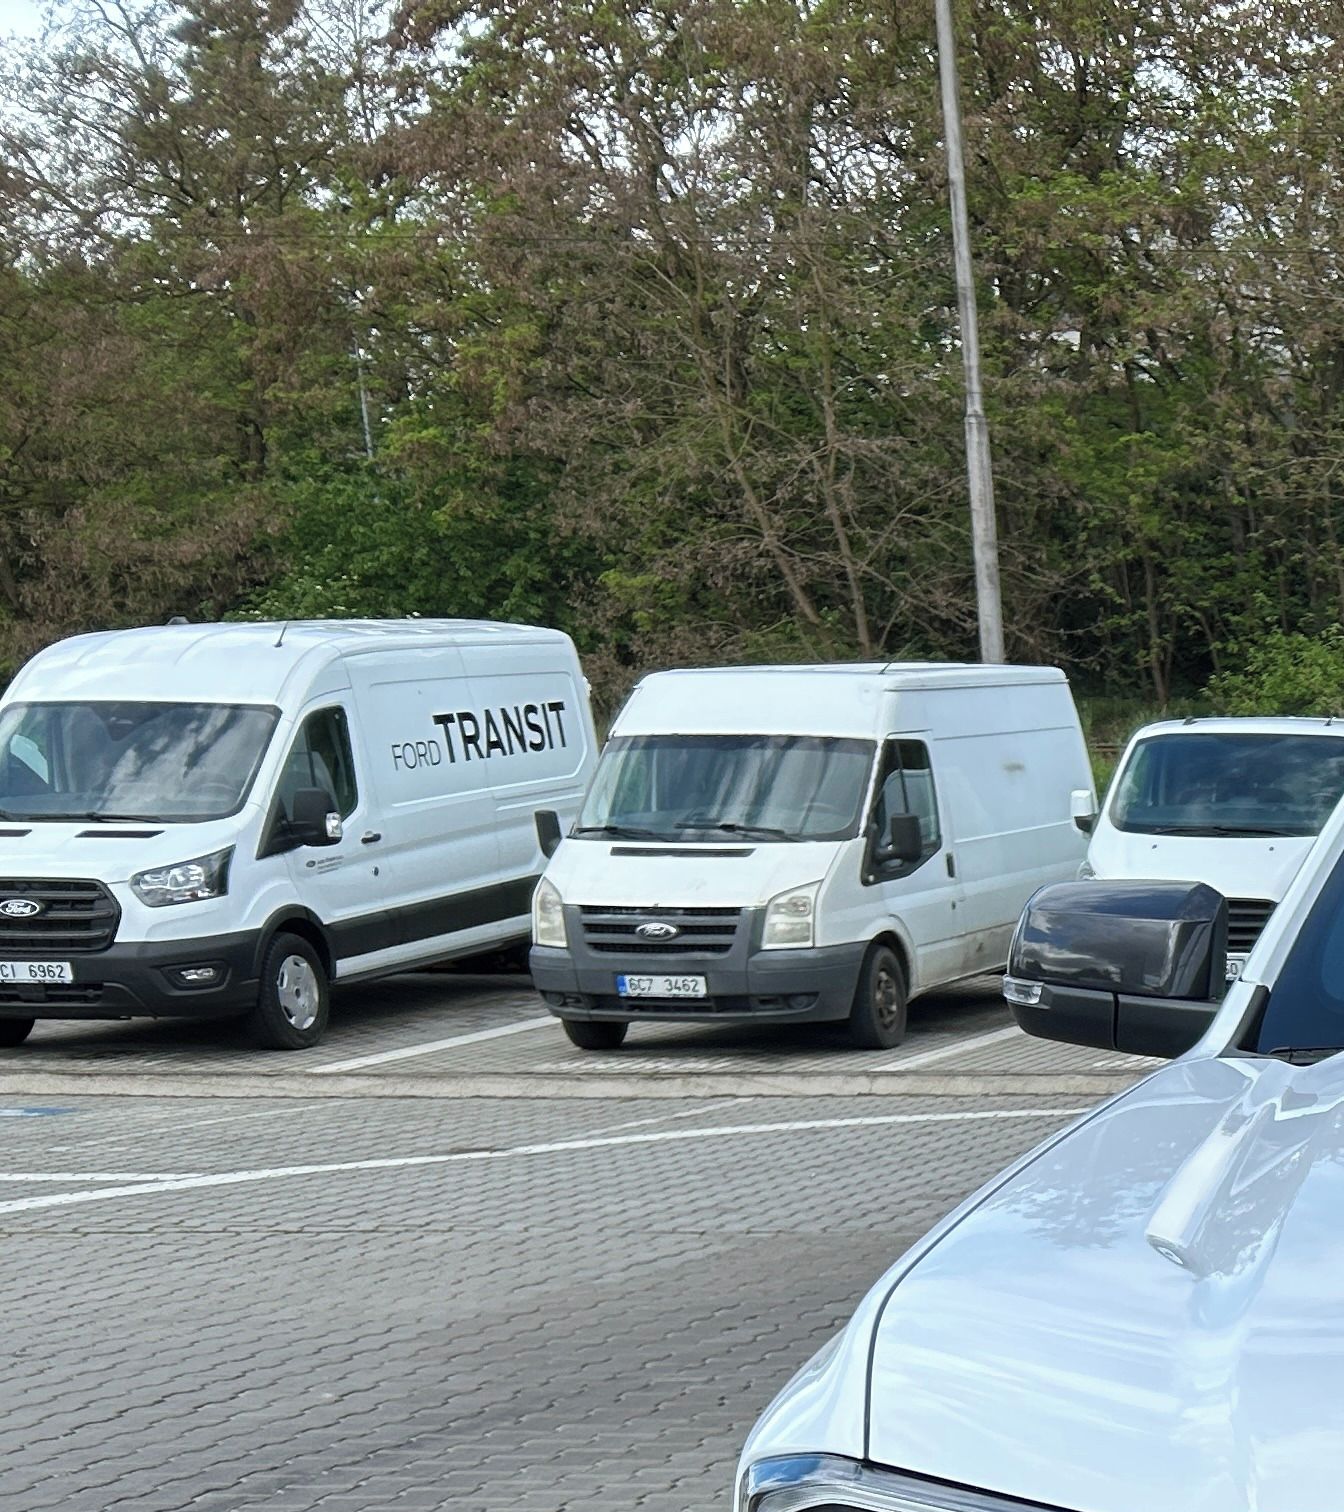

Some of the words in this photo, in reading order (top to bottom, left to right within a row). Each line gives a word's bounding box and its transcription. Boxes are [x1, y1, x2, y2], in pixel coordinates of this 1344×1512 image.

[391, 740, 441, 771] FORD
[432, 701, 566, 764] TRANSIT
[28, 964, 66, 979] 6962
